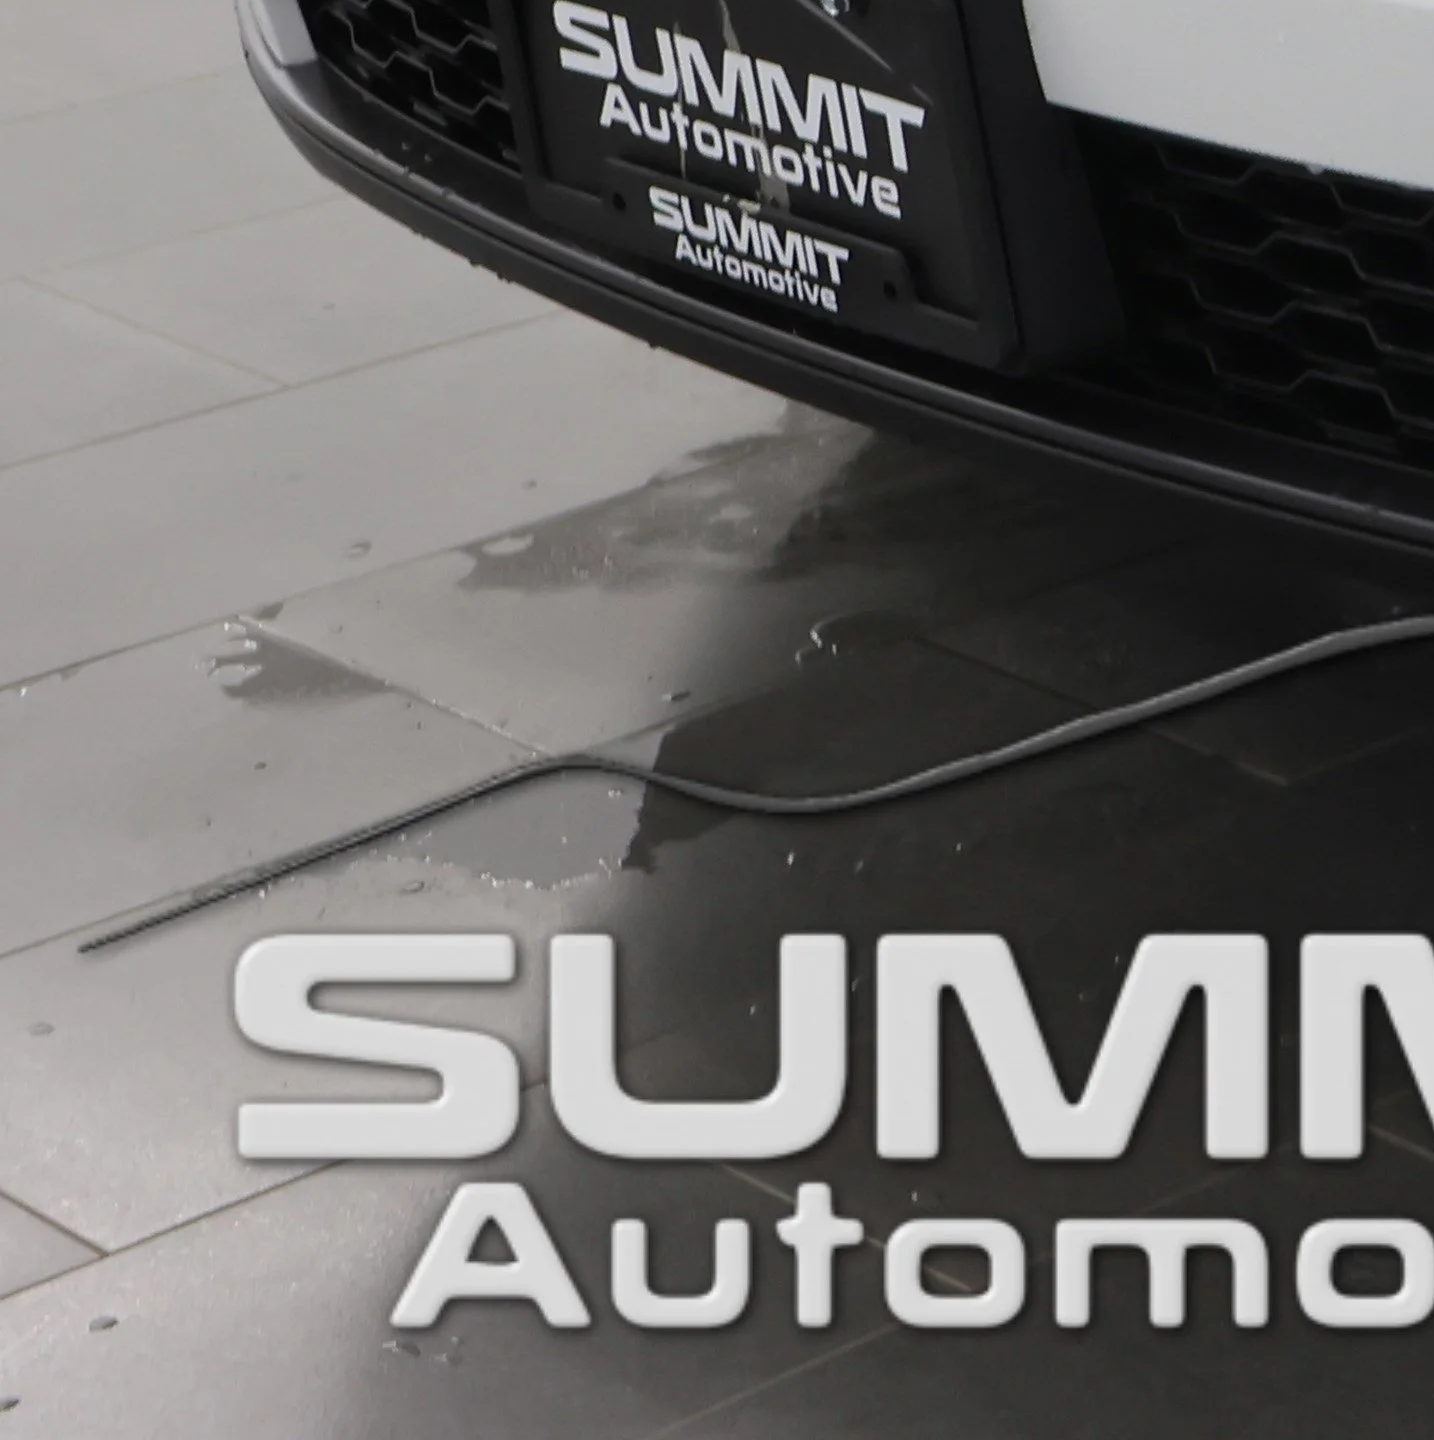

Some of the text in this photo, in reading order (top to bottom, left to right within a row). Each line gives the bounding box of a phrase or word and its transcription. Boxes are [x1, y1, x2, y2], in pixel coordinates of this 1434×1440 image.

[599, 83, 902, 220] Automotive
[648, 186, 850, 286] SUMMIT
[675, 234, 839, 314] Automotive
